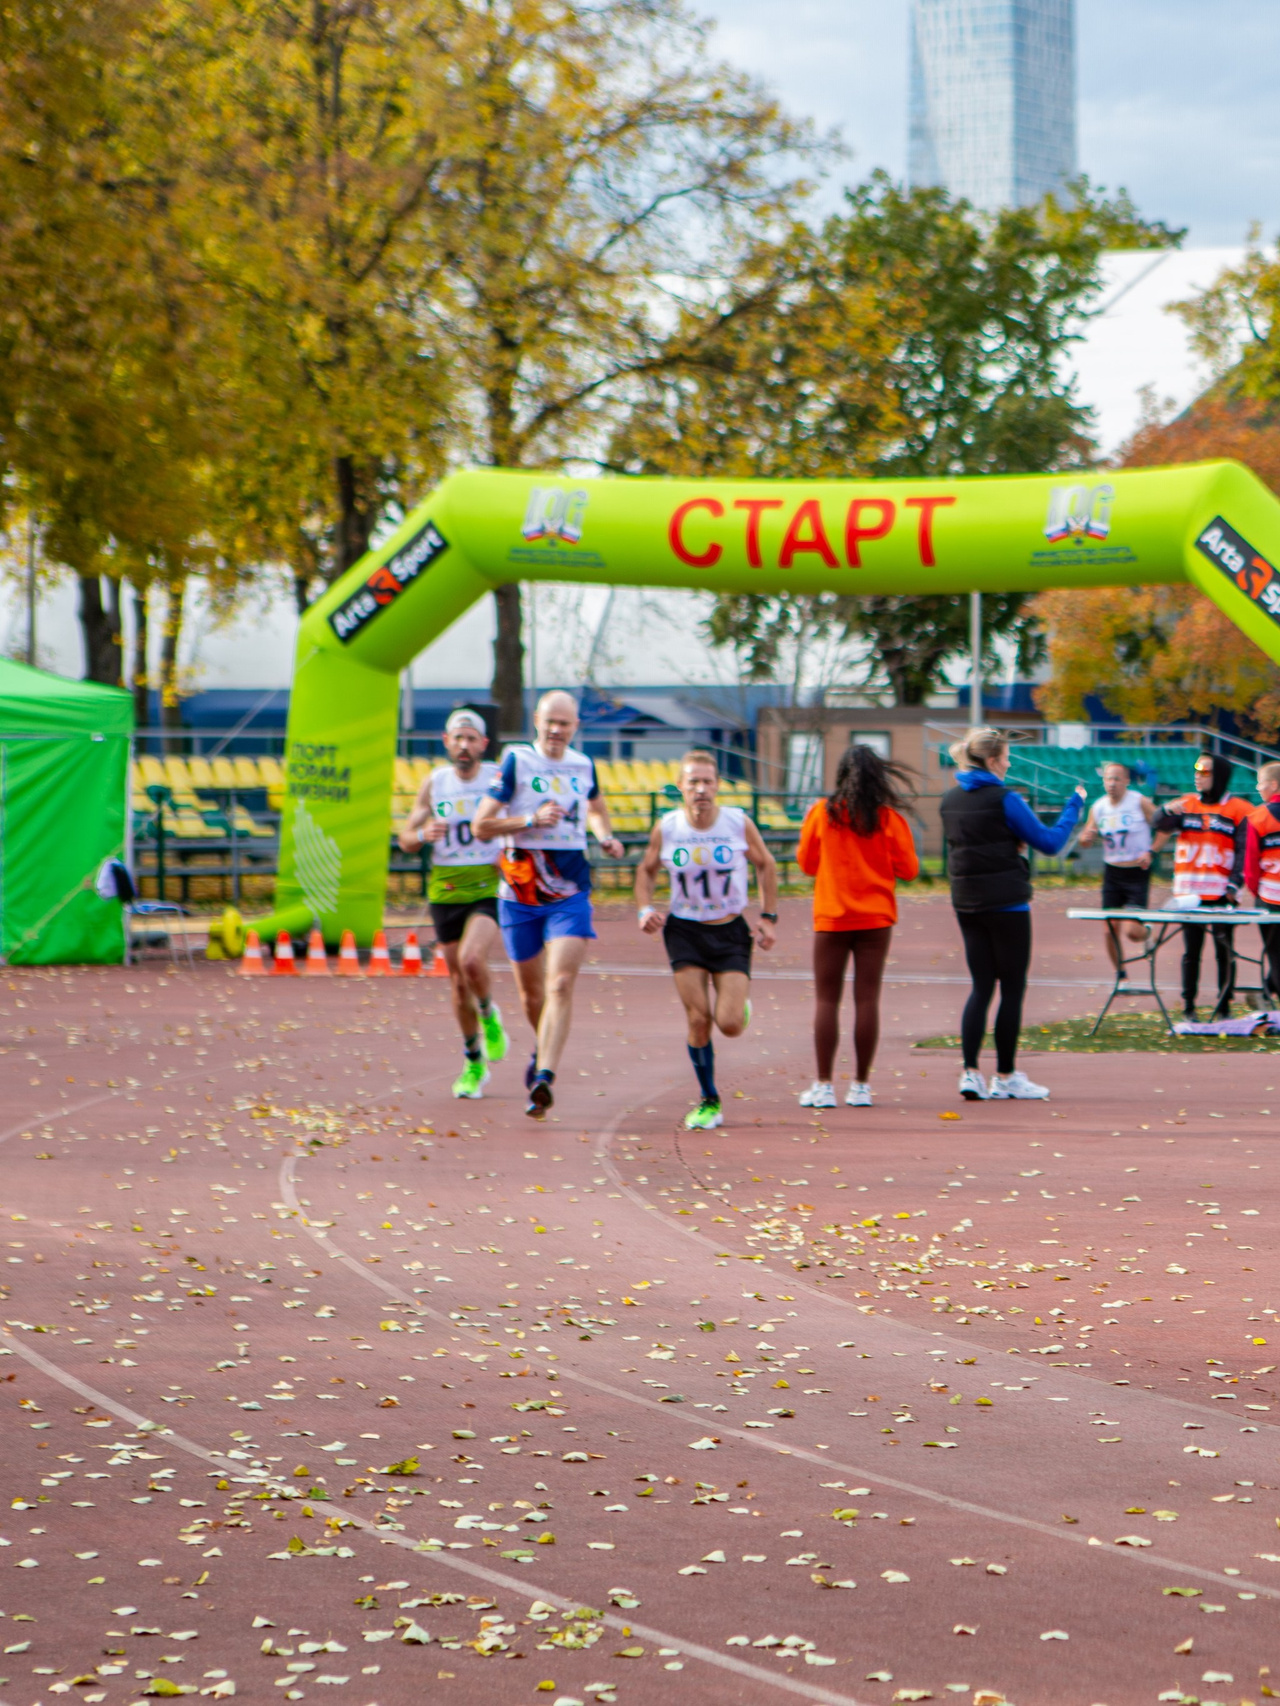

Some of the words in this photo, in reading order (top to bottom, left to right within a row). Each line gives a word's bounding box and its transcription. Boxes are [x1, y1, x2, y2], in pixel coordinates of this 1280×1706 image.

[668, 496, 957, 569] СТАРТ
[1200, 526, 1245, 573] Arta
[333, 592, 377, 638] Arta
[390, 528, 443, 582] Sport
[292, 743, 338, 763] ПОРТ
[677, 869, 735, 899] 117
